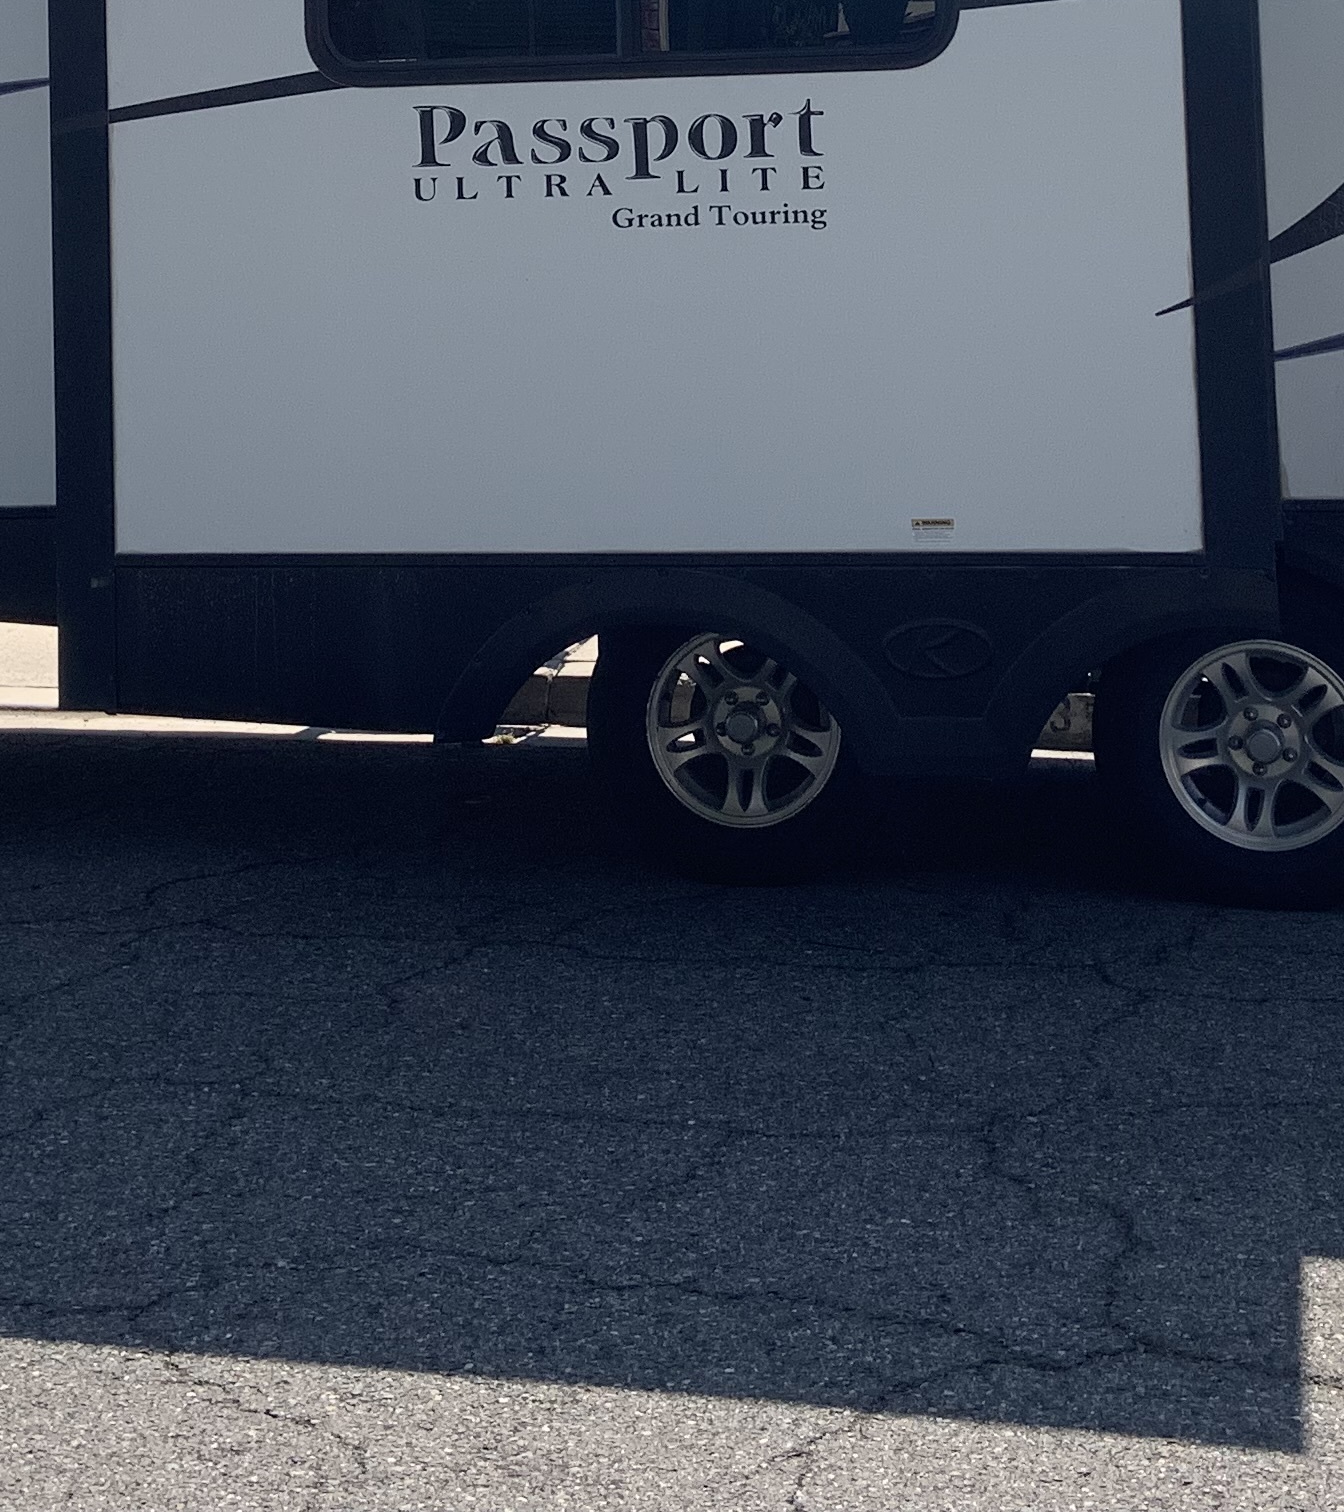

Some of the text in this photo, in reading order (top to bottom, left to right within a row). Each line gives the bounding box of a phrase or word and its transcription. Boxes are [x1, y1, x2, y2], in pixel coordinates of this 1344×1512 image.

[411, 98, 825, 181] Passport
[412, 165, 825, 202] ULTRA LITE
[611, 202, 828, 231] Grand Touring
